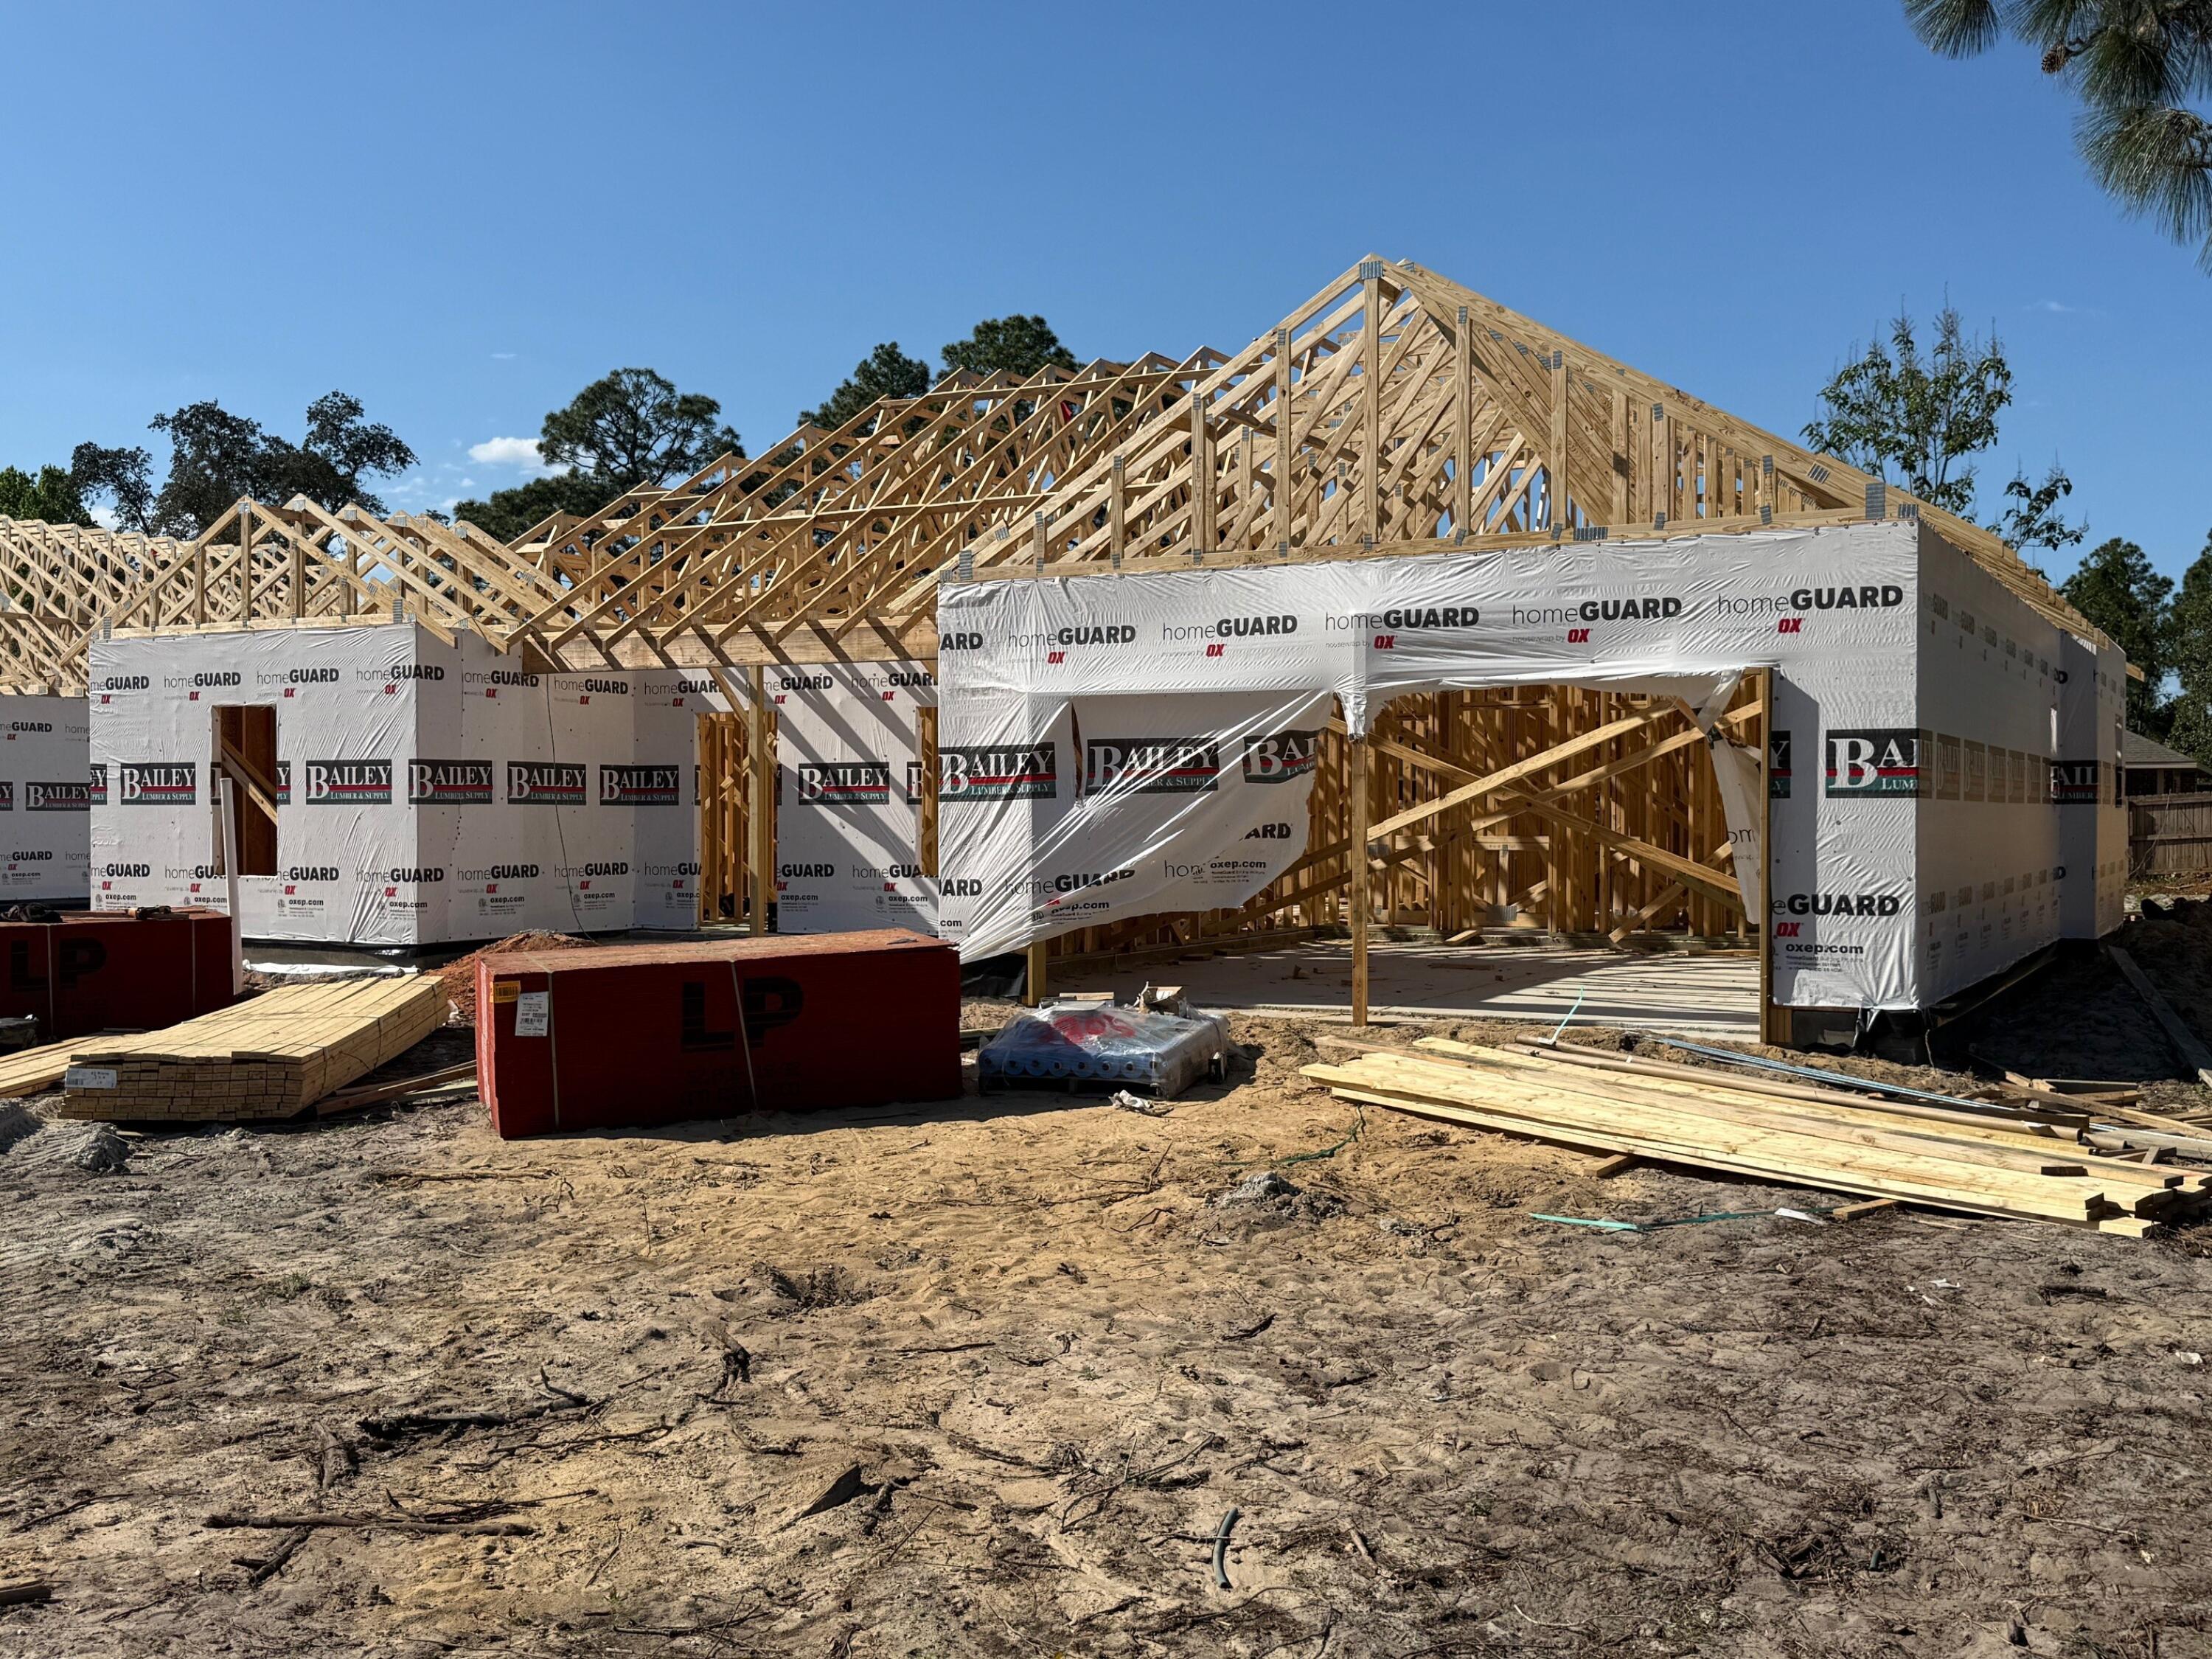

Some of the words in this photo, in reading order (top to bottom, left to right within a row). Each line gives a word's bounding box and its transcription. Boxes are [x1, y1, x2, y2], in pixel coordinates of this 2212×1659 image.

[1718, 585, 1903, 614] homeGUARD
[1512, 597, 1682, 625] homeGUARD
[1326, 607, 1480, 630] homeGUARD
[1163, 615, 1298, 641] homeGUARD
[1778, 618, 1802, 633] OX
[1008, 625, 1136, 647] homeGUARD
[1568, 628, 1590, 643] OX
[1374, 636, 1395, 649] OX
[1206, 644, 1225, 657] OX
[1047, 651, 1065, 664] OX
[257, 667, 339, 685] homeGUARD
[356, 664, 445, 681] homeGUARD
[164, 672, 241, 689] homeGUARD
[554, 676, 628, 695] homeGUARD
[284, 688, 296, 698] OX
[384, 684, 397, 695] OX
[485, 688, 497, 698] OX
[882, 691, 895, 700] OX
[101, 695, 111, 704] OX
[189, 692, 201, 700] OX
[580, 695, 590, 705] OX
[774, 695, 786, 704] OX
[672, 698, 684, 707] OX
[122, 768, 195, 799] BAILEY
[307, 765, 391, 799] BAILEY
[409, 765, 492, 798] BAILEY
[508, 766, 585, 799] BAILEY
[600, 769, 678, 801] BAILEY
[799, 768, 889, 800] BAILEY
[172, 792, 192, 800] SUPPLY
[330, 791, 358, 799] LUMBER
[365, 790, 388, 799] SUPPLY
[860, 792, 886, 801] SUPPLY
[554, 862, 628, 877] homeGUARD
[1210, 860, 1267, 871] oxep.com
[356, 867, 444, 883] homeGUARD
[458, 864, 539, 880] homeGUARD
[102, 881, 113, 890] OX
[189, 883, 201, 893] OX
[285, 885, 296, 895] OX
[486, 884, 498, 894] OX
[580, 880, 591, 890] OX
[672, 880, 684, 888] OX
[883, 882, 897, 892] OX
[385, 887, 397, 897] OX
[781, 894, 818, 902] oxep.com
[288, 898, 324, 907] oxep.com
[389, 900, 428, 909] oxep.com
[490, 895, 524, 904] oxep.com
[888, 895, 928, 903] oxep.com
[1773, 894, 1900, 916] eGUARD
[1775, 922, 1801, 937] OX
[1786, 942, 1864, 954] oxep.com
[681, 976, 804, 1054] LP
